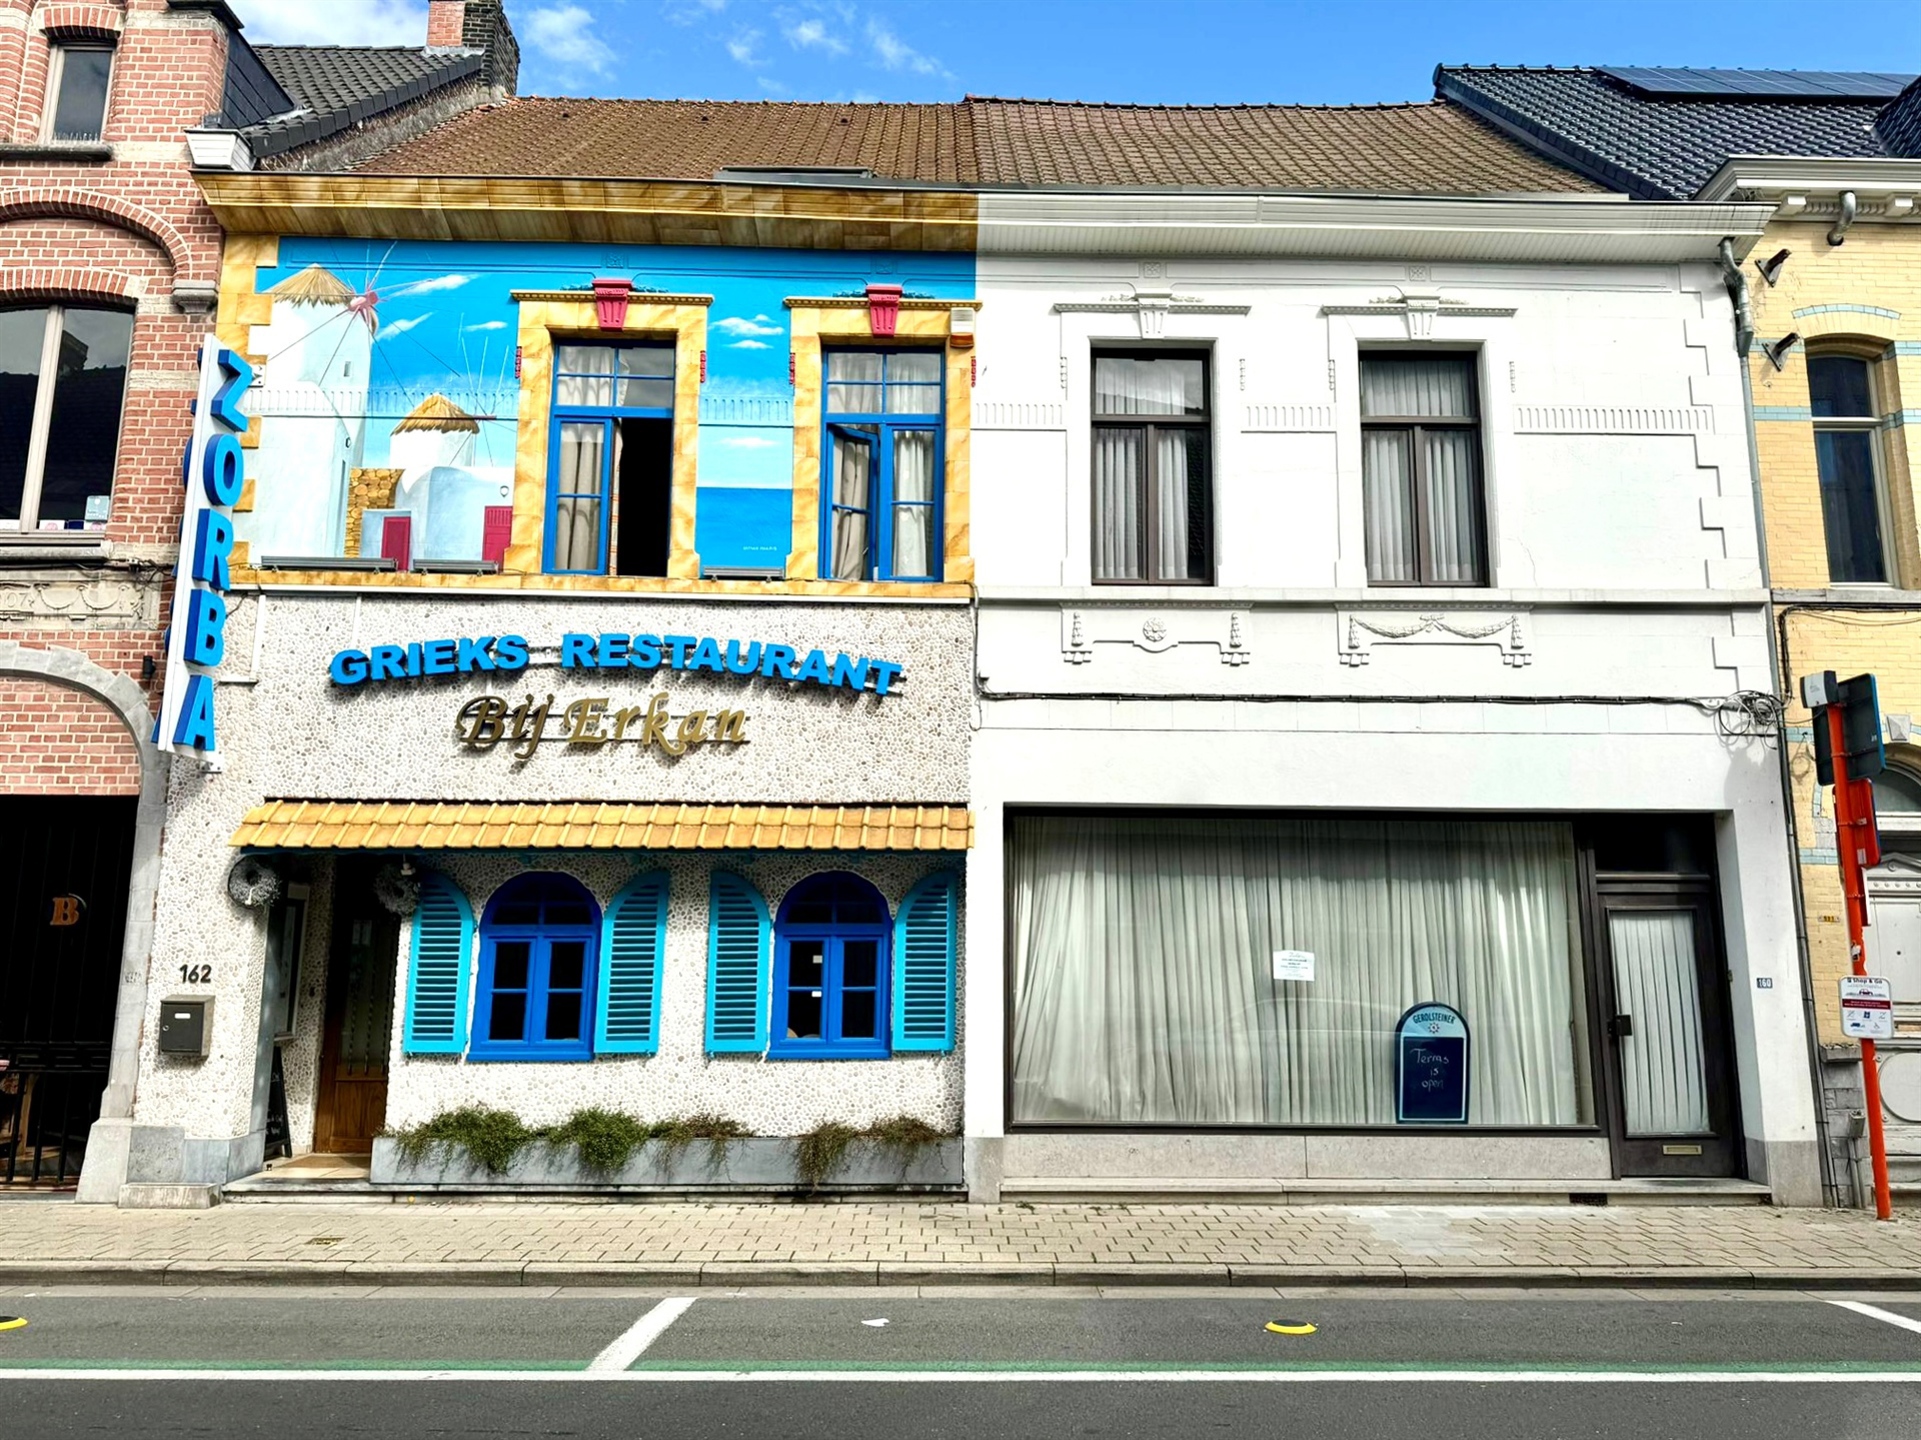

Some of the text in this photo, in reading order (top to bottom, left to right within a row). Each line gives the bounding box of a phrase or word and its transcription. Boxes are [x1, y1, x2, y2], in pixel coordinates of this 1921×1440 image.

[173, 349, 253, 751] ZORBA
[329, 632, 902, 696] GRIEKS RESTAURANT
[454, 690, 748, 760] Bij Erkan
[179, 964, 212, 984] 162
[1758, 978, 1772, 988] 160
[1412, 1012, 1456, 1024] GEROLSTEINER
[1410, 1048, 1449, 1064] Terras
[1430, 1067, 1439, 1077] is
[1421, 1079, 1444, 1092] open
